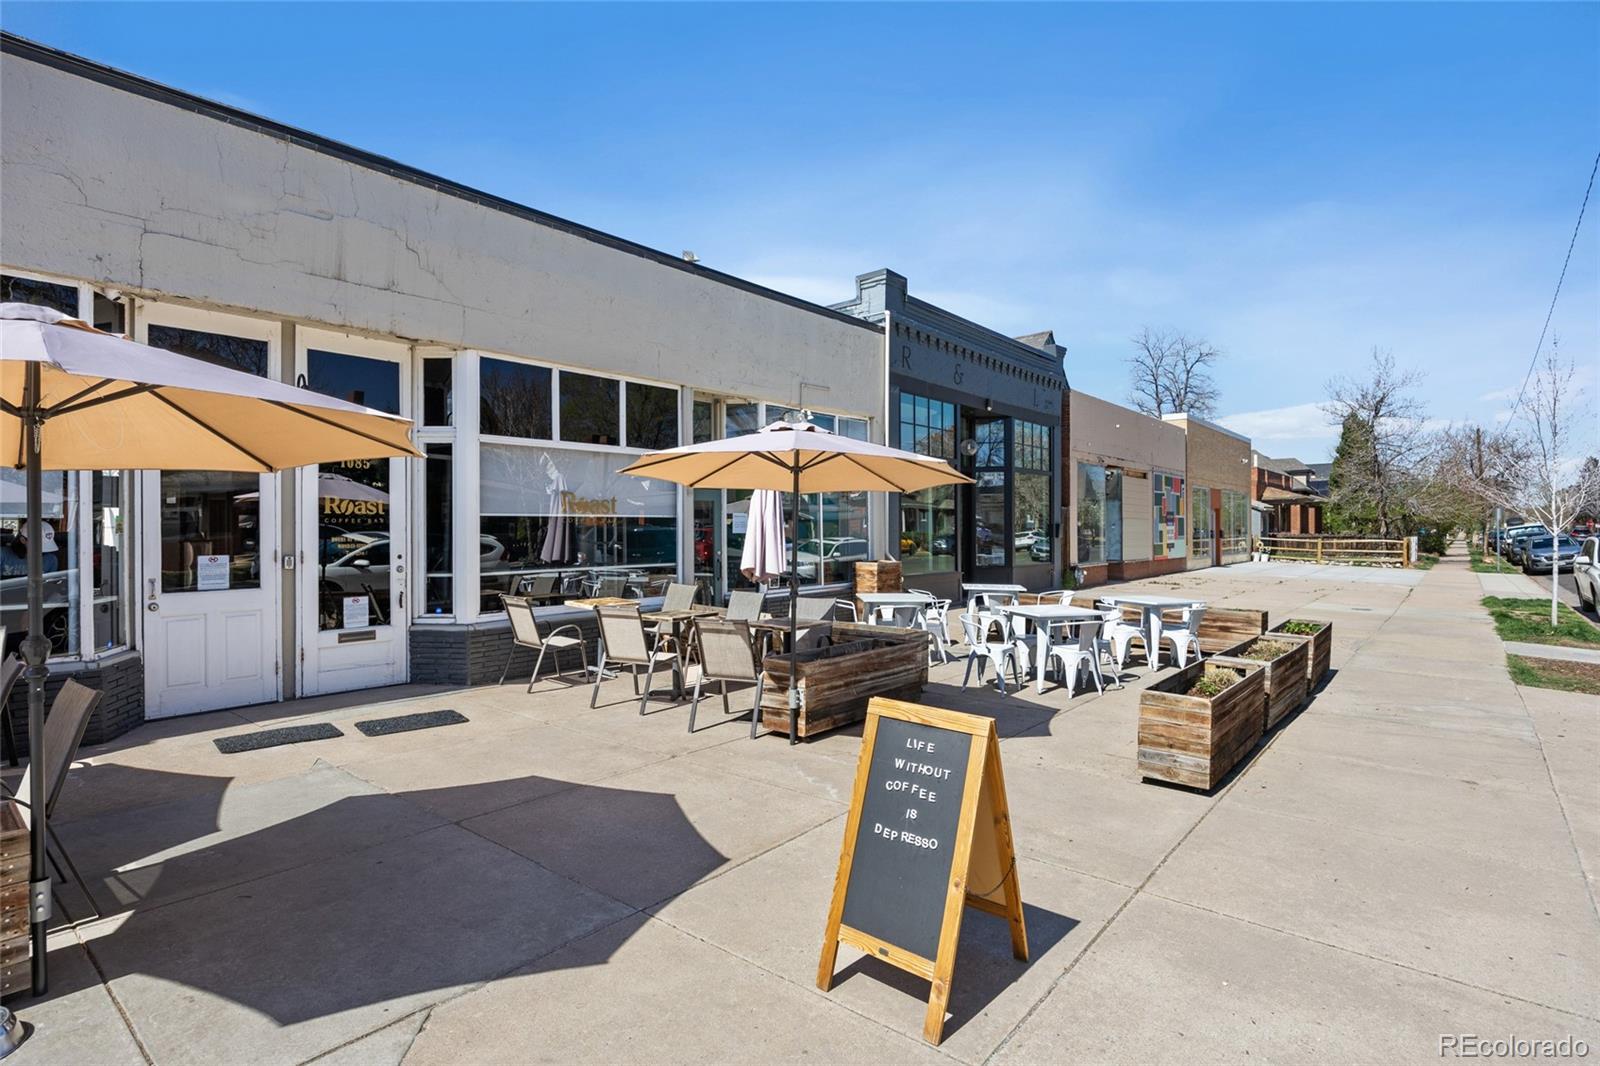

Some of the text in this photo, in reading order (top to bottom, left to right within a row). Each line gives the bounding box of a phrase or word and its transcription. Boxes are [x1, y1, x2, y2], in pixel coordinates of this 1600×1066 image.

[901, 345, 912, 371] R
[340, 459, 370, 470] 1085
[324, 496, 385, 515] Roast
[906, 738, 936, 753] LIFE
[894, 758, 951, 780] WITHOUT
[885, 780, 937, 803] COFFEE
[905, 808, 918, 820] IS
[874, 823, 938, 850] DEPRESSO
